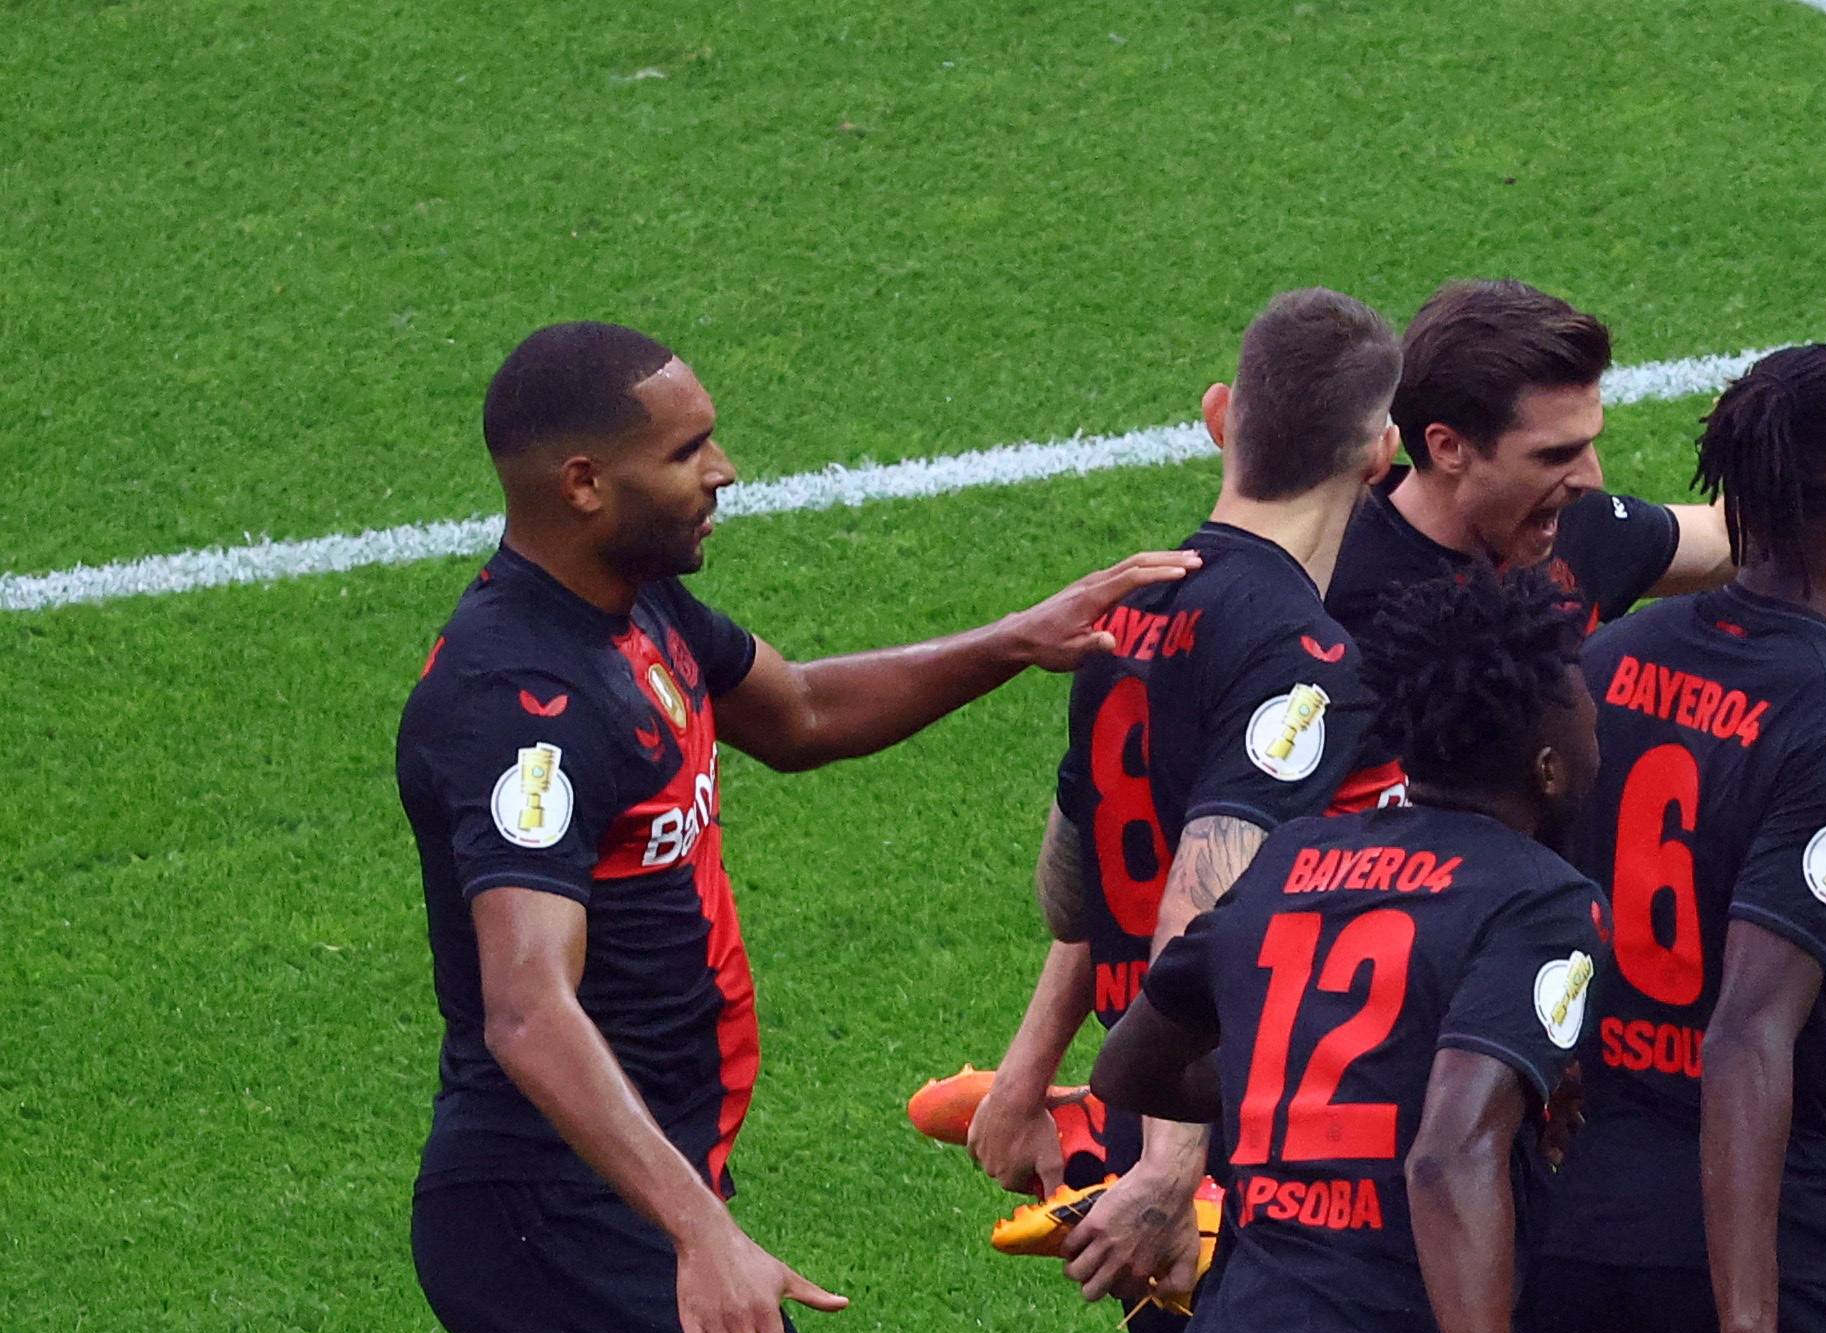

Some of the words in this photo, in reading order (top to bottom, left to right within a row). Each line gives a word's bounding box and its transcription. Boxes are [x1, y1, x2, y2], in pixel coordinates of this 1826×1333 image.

[1090, 677, 1172, 937] 8
[1606, 655, 1725, 733] BAYER
[1283, 847, 1407, 893] BAYER
[1396, 851, 1464, 893] 04
[1613, 743, 1705, 1006] 6
[1229, 909, 1416, 1166] 12
